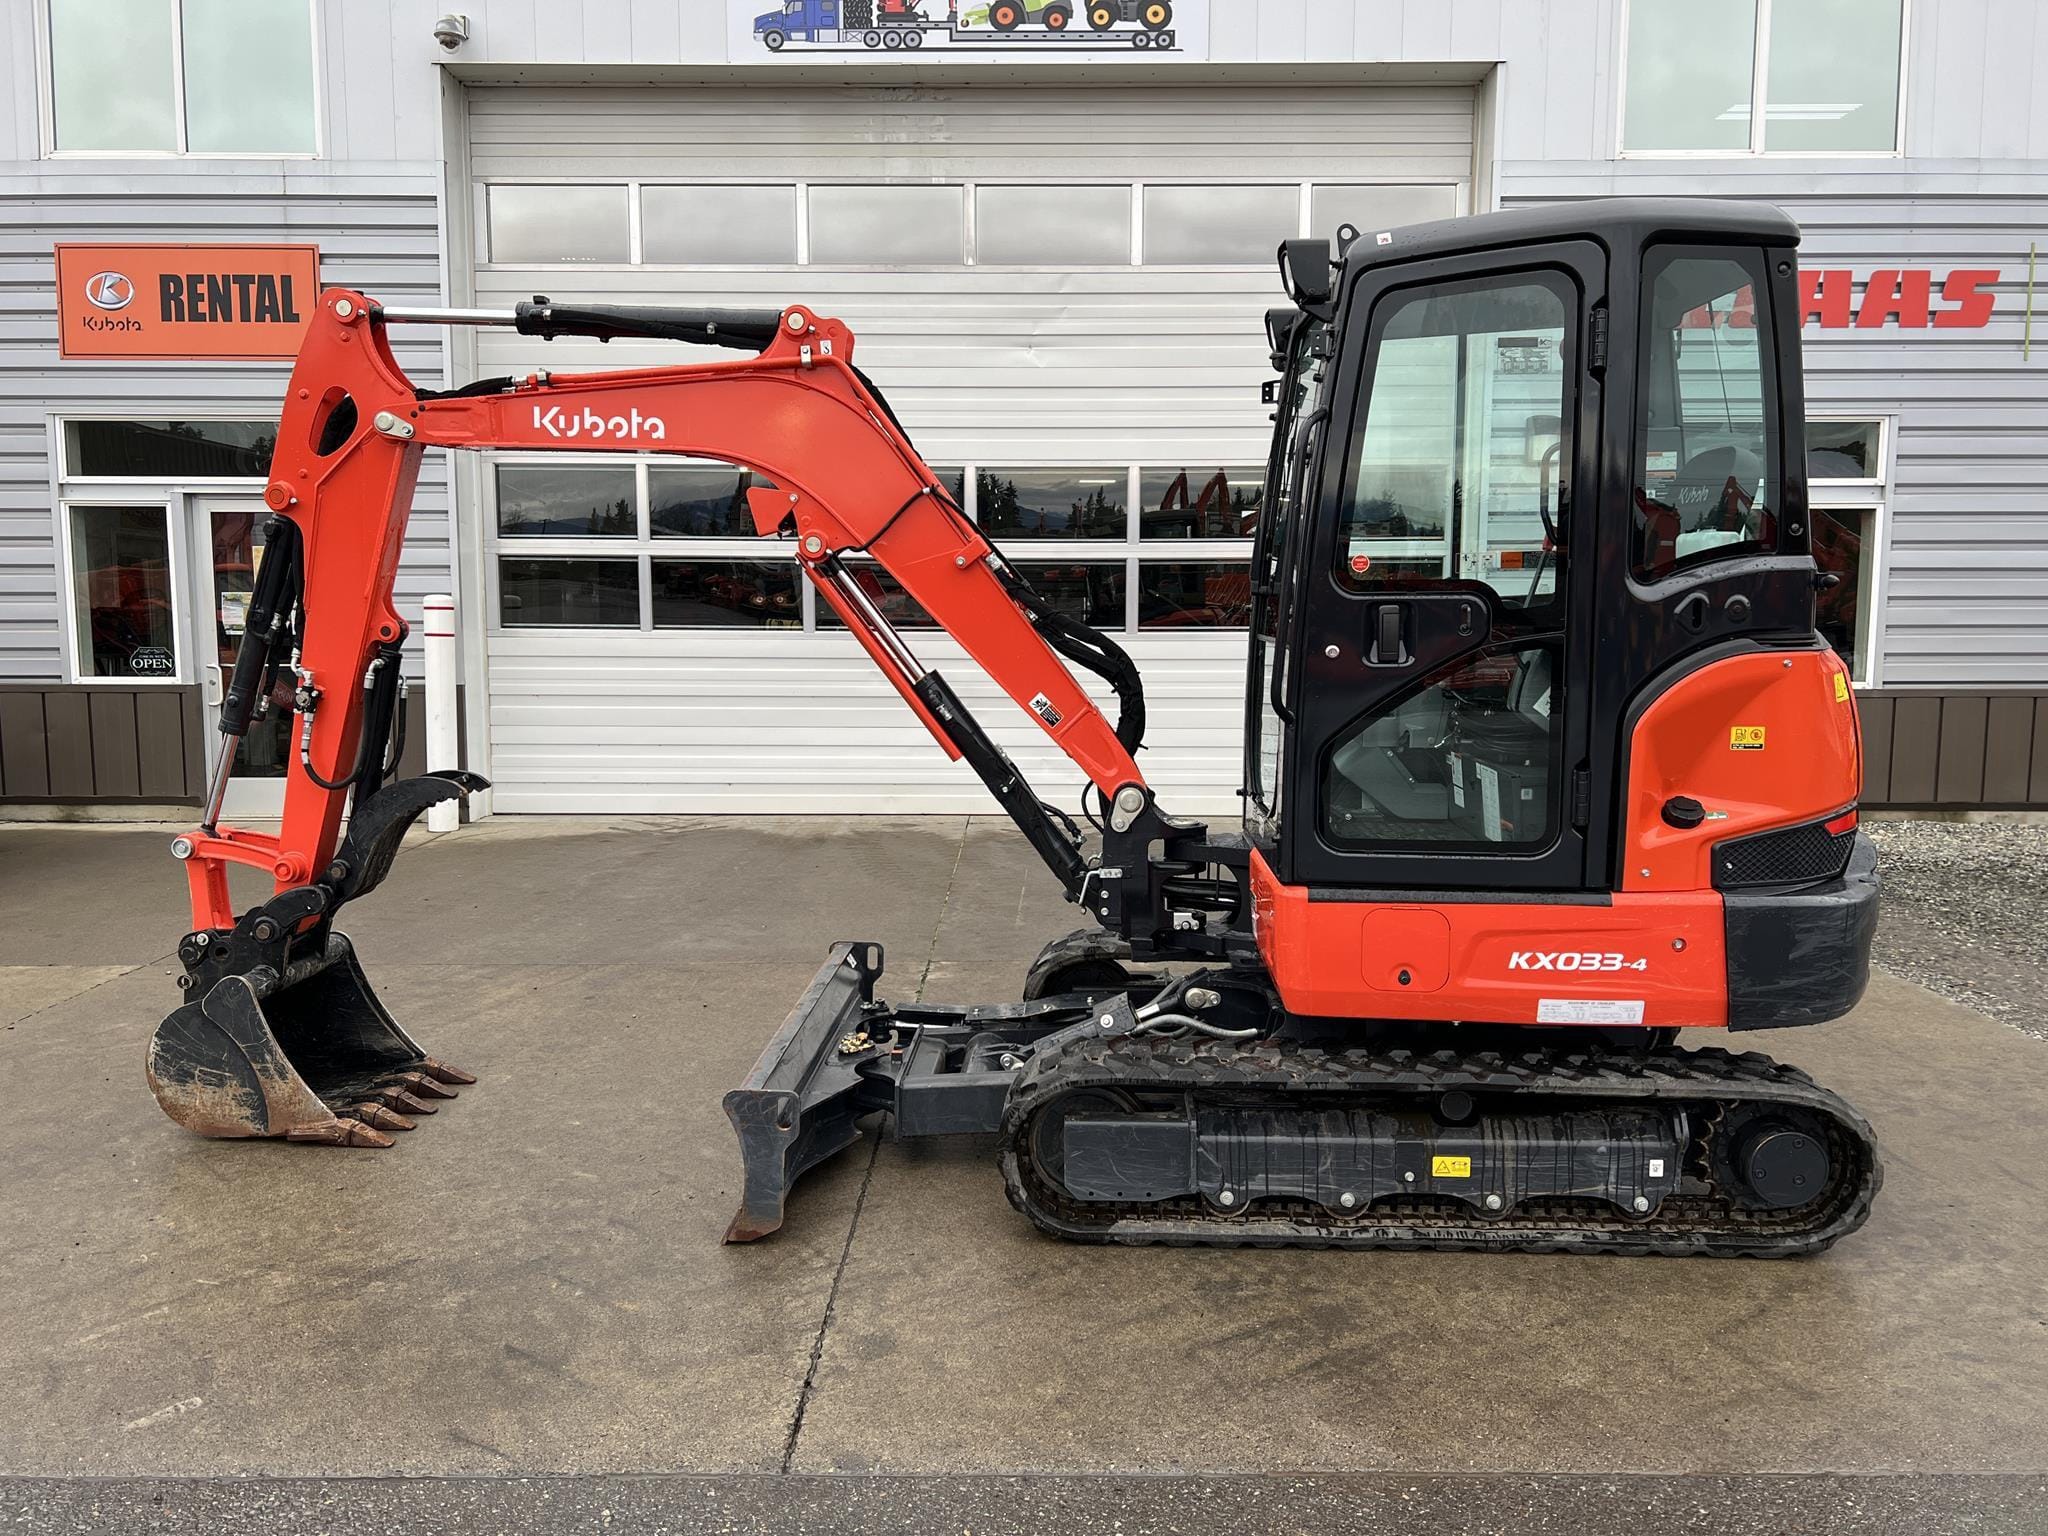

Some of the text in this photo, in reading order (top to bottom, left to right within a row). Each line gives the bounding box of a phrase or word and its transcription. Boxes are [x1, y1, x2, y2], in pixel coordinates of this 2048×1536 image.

[159, 274, 300, 323] RENTAL
[83, 316, 142, 332] Kubota
[533, 406, 666, 439] Kubota
[132, 659, 172, 668] OPEN
[1508, 952, 1647, 971] KX033-4
